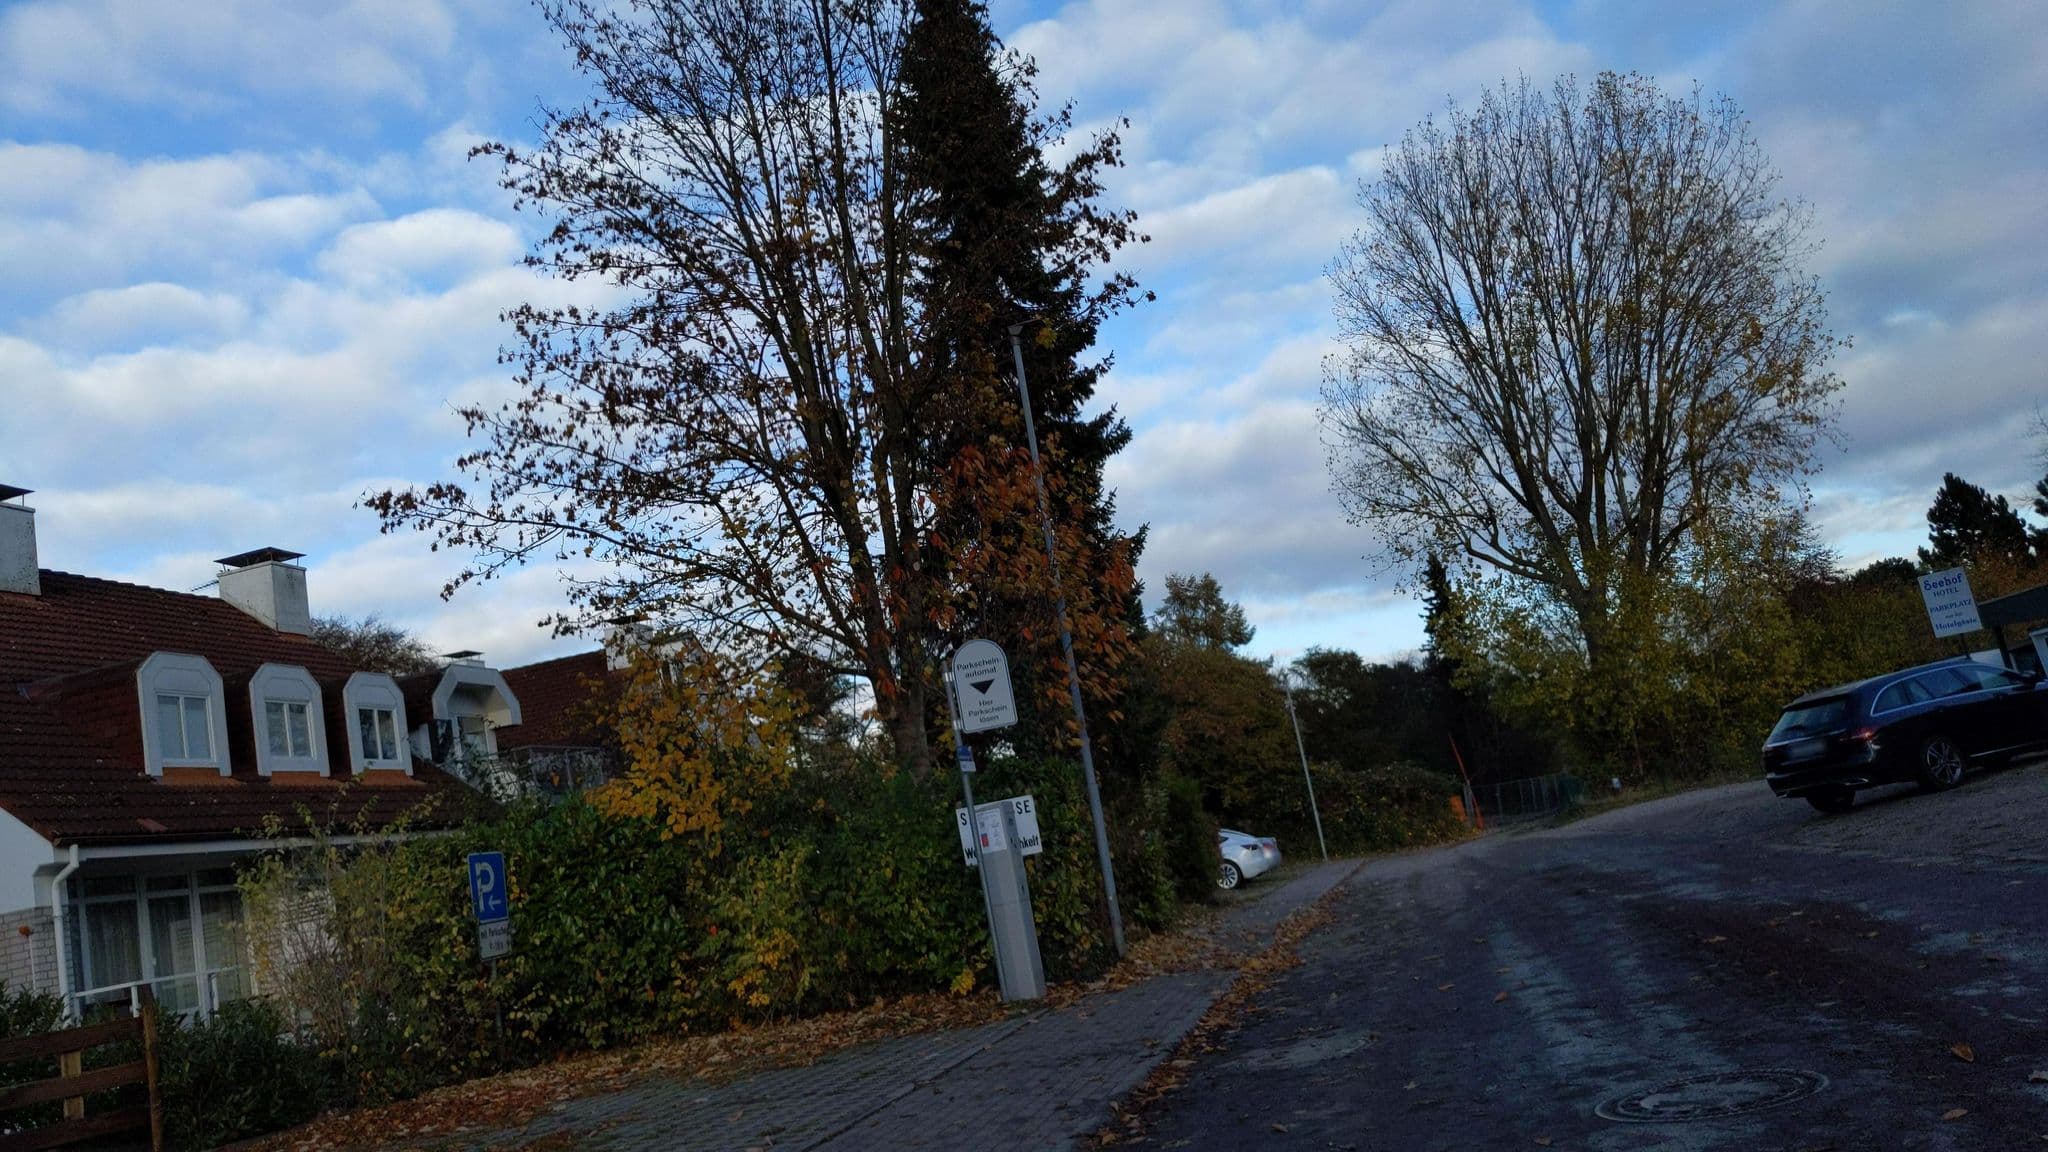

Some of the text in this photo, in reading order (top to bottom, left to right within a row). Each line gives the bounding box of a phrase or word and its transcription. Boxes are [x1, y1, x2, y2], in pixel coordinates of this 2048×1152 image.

[1923, 573, 1963, 591] Seehof
[1933, 586, 1960, 597] HOTEL
[1929, 598, 1972, 613] PARKPLATZ
[968, 704, 1008, 717] Parkschein
[475, 862, 495, 913] P
